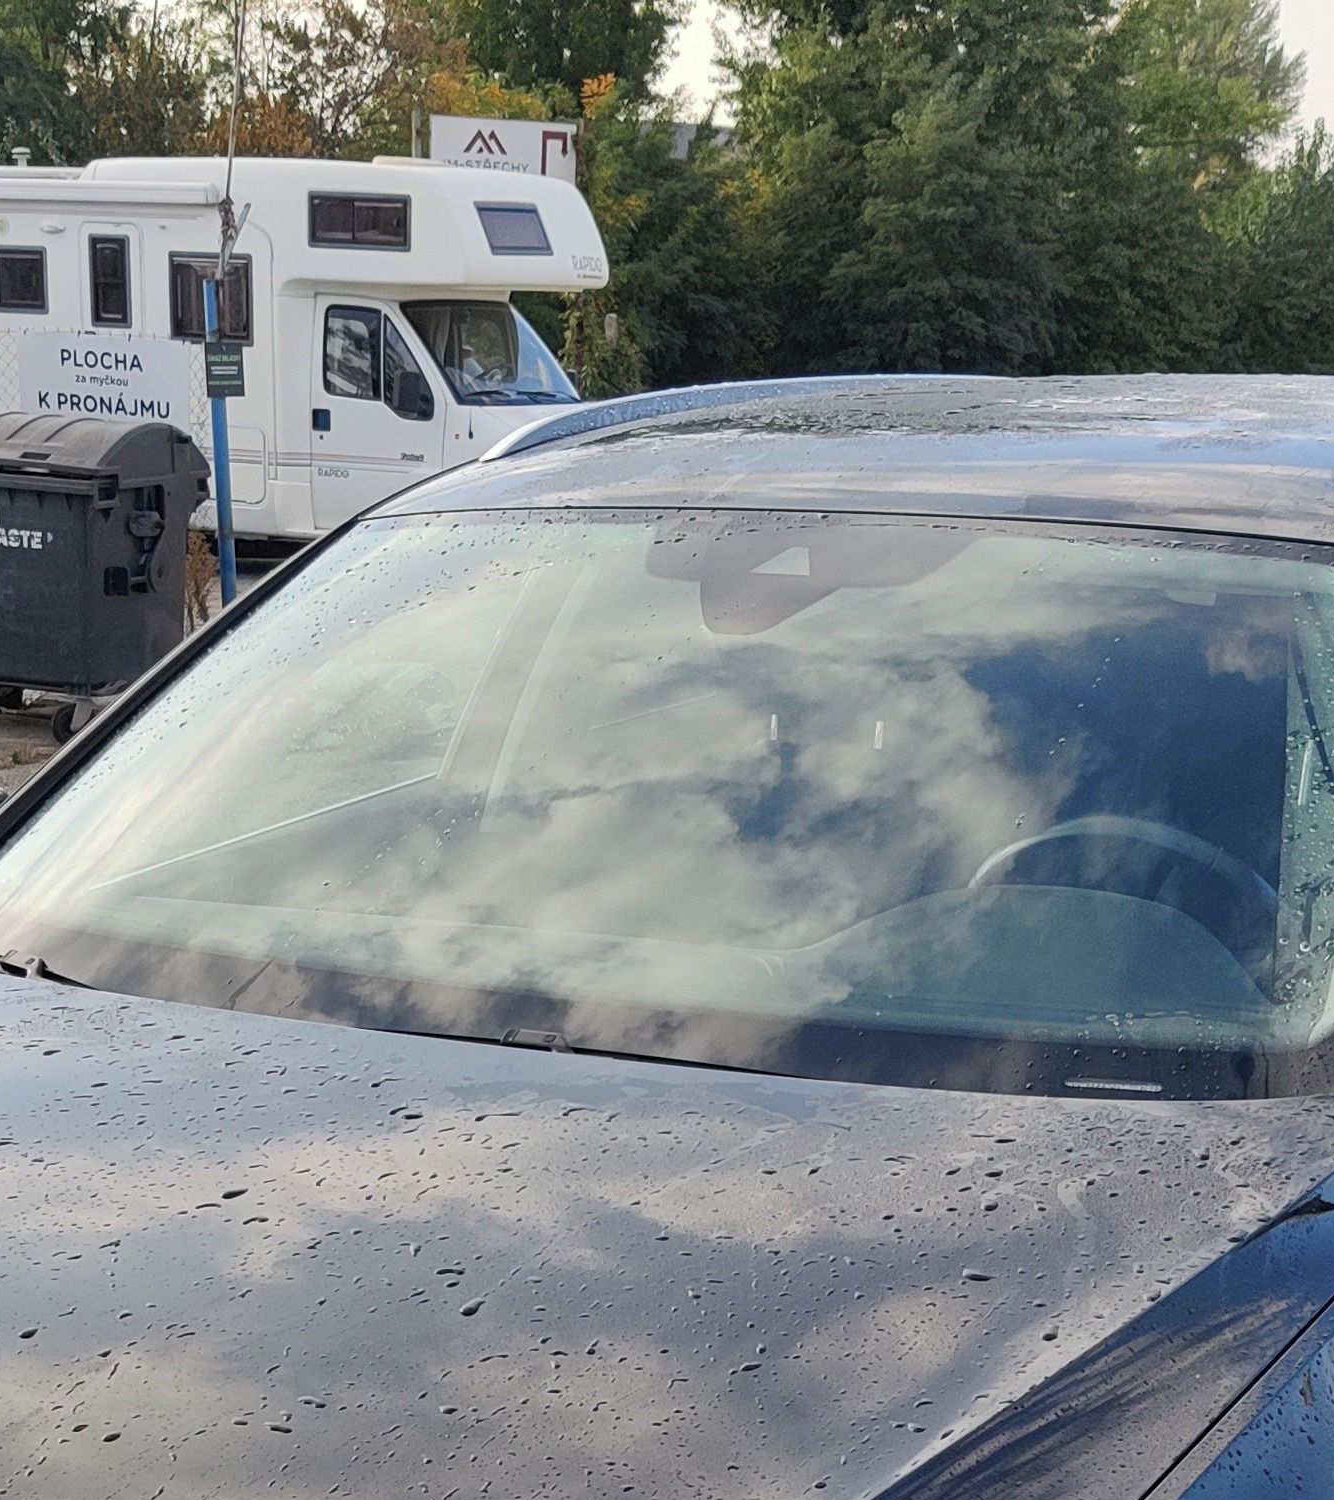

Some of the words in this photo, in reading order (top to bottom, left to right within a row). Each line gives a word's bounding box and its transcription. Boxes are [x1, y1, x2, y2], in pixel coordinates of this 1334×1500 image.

[571, 256, 603, 272] RAPIDO
[60, 348, 143, 373] PLOCHA
[75, 374, 87, 384] za
[90, 375, 129, 387] myčkou
[38, 391, 51, 409] K
[57, 392, 171, 419] PRONÁJMU
[318, 468, 349, 479] RAPIDO
